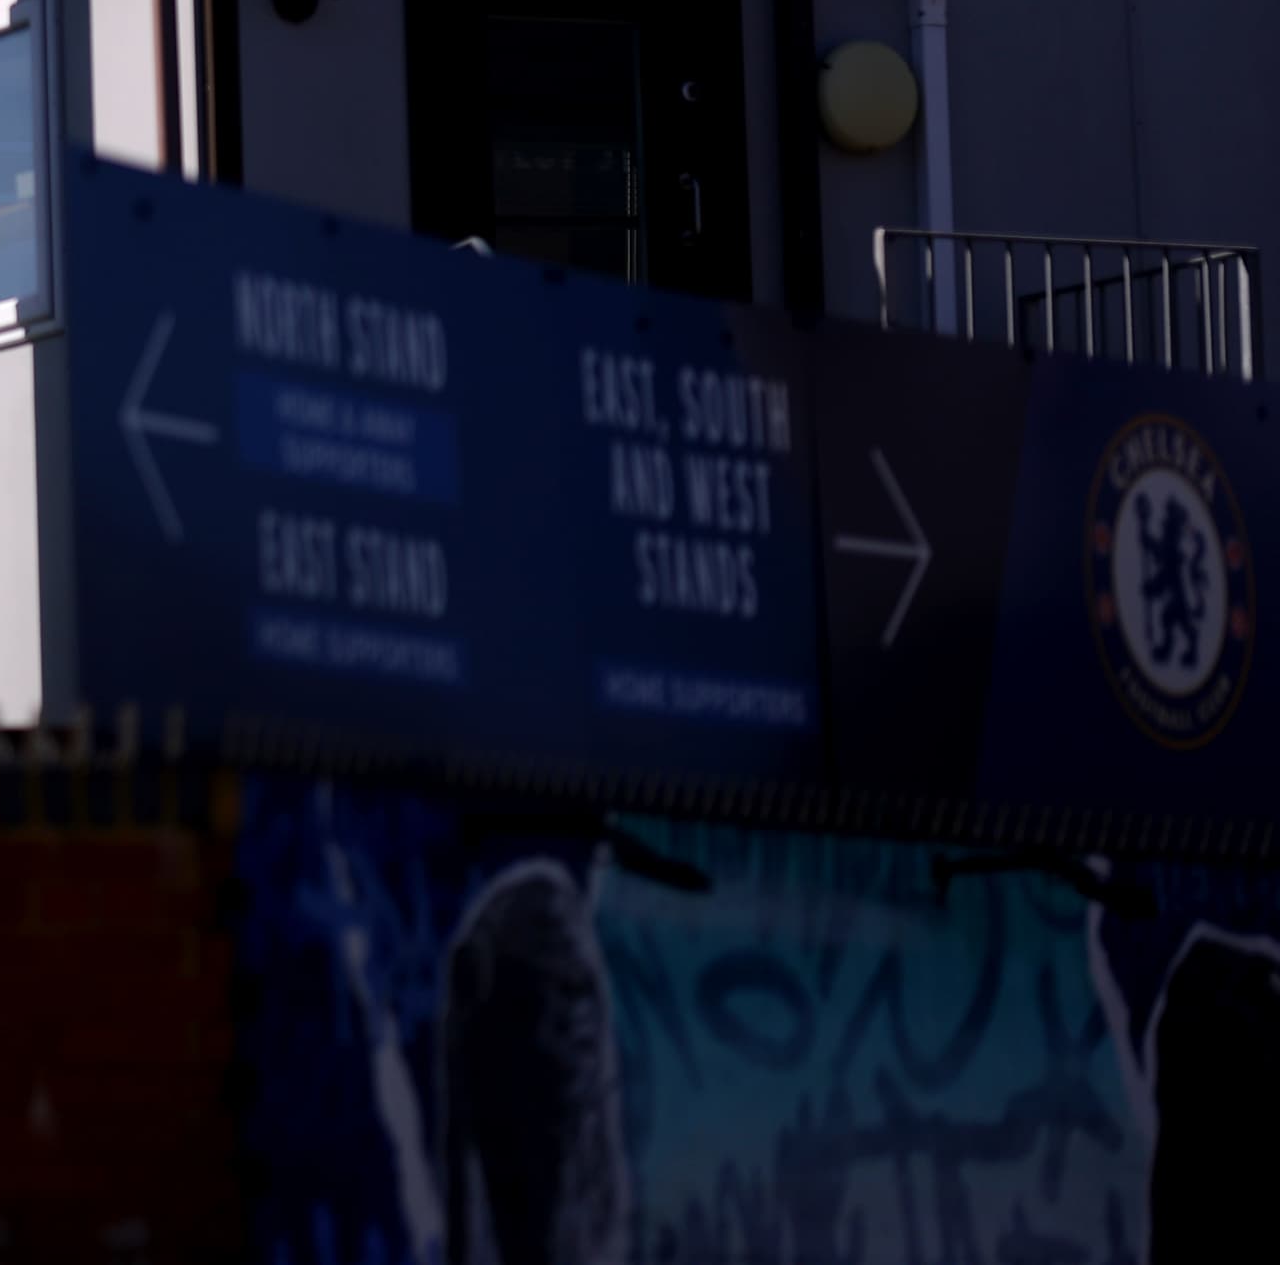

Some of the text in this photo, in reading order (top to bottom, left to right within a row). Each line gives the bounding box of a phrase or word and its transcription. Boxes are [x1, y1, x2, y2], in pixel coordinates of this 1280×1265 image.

[237, 270, 447, 391] NORTH STAND
[581, 347, 790, 452] EAST, SOUTH
[611, 443, 770, 533] AND WEST
[260, 509, 447, 618] EAST STAND
[634, 532, 757, 618] STANDS
